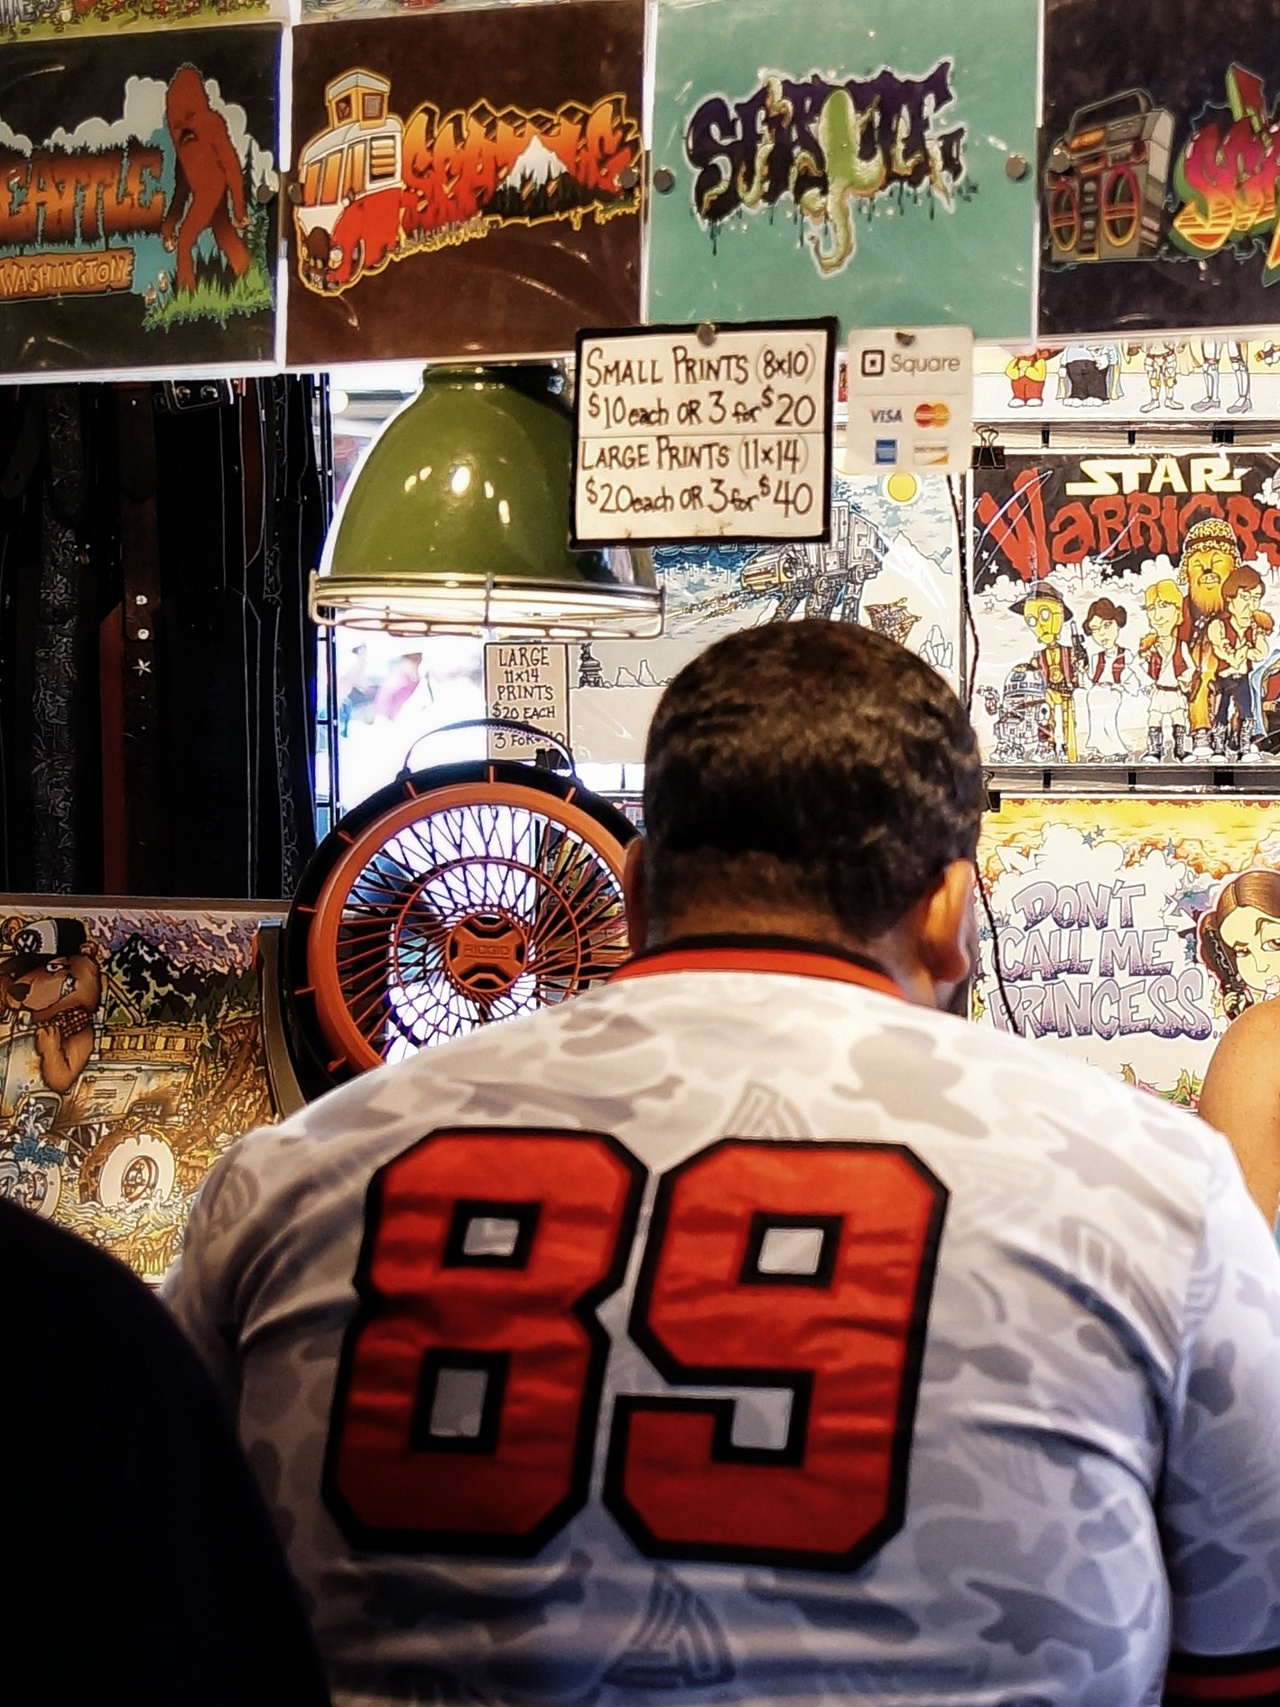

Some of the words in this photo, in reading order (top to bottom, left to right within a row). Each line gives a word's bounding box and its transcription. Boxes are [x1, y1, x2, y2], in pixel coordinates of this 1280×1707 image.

[1, 253, 127, 296] WASHINGTON
[587, 347, 663, 388] SMALL
[672, 345, 749, 385] PRINTS
[890, 354, 961, 377] Square
[677, 399, 703, 425] OR
[708, 390, 727, 425] 3
[870, 408, 903, 423] VISA
[581, 441, 650, 471] LARGE
[656, 435, 730, 471] PRINTS
[1066, 457, 1242, 496] STAR
[679, 486, 704, 510] OR
[707, 478, 728, 513] 3
[499, 647, 549, 667] LARGE
[497, 685, 553, 701] PRINTS
[504, 668, 539, 683] 11x14
[492, 701, 519, 719] $20
[523, 705, 556, 719] EACH
[494, 732, 506, 749] 3
[1011, 880, 1148, 932] DON'T
[998, 928, 1093, 983] CALL
[1100, 929, 1173, 978] ME
[321, 1125, 952, 1573] 89
